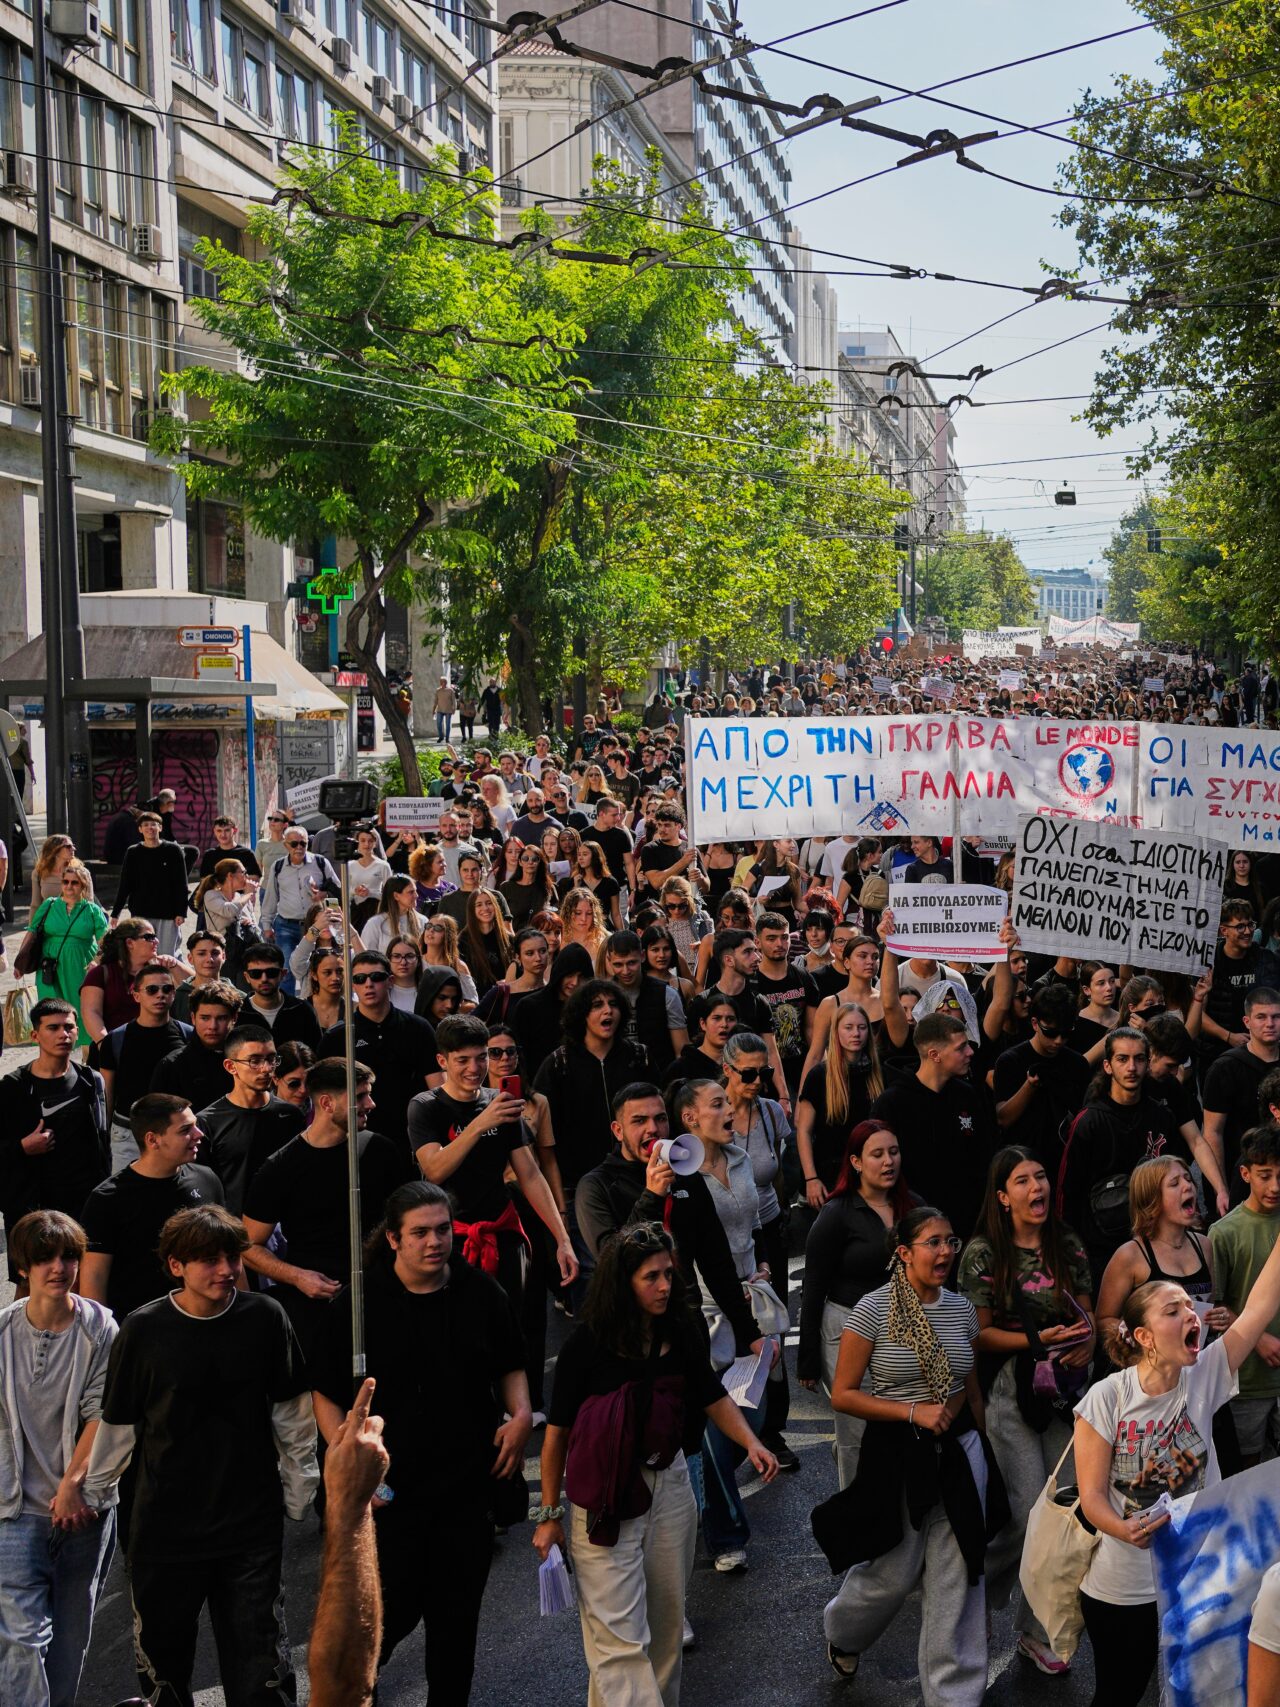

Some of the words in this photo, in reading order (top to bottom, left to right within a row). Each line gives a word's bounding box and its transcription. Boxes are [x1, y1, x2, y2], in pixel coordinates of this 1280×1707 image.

[694, 726, 789, 761] ΑΠΟ
[807, 726, 873, 755] ΤΗΝ
[887, 721, 1012, 752] ΓΚΡΑΒΑ
[1035, 726, 1059, 744] LE
[1065, 725, 1139, 747] MONDE
[1149, 736, 1187, 765] ΟΙ
[699, 774, 815, 813] ΜΕΧΡΙ
[824, 774, 875, 803] ΤΗ
[900, 770, 1017, 800] ΓΑΛΛΙΑ
[1150, 776, 1193, 797] ΓΙΑ
[1023, 817, 1078, 854] ΟΧΙ
[1020, 858, 1189, 900] ΠΑΝΕΠΙΣΤΗΜΙΑ
[893, 897, 909, 907] ΝΑ
[912, 895, 1002, 907] ΣΠΟΥΔΑΣΟΥΜΕ
[1019, 882, 1176, 923] ΔΙΚΑΙΟΥΜΑΣΤΕ
[1181, 906, 1209, 929] ΤΟ
[893, 923, 909, 934] ΝΑ
[912, 921, 1001, 934] ΕΠΙΒΙΩΣΟΥΜΕ;
[1015, 904, 1093, 935] ΜΕΛΛΟΝ
[1100, 917, 1131, 945] ΠΟΥ
[1138, 926, 1215, 969] ΑΞΙΖΟΥΜΕ
